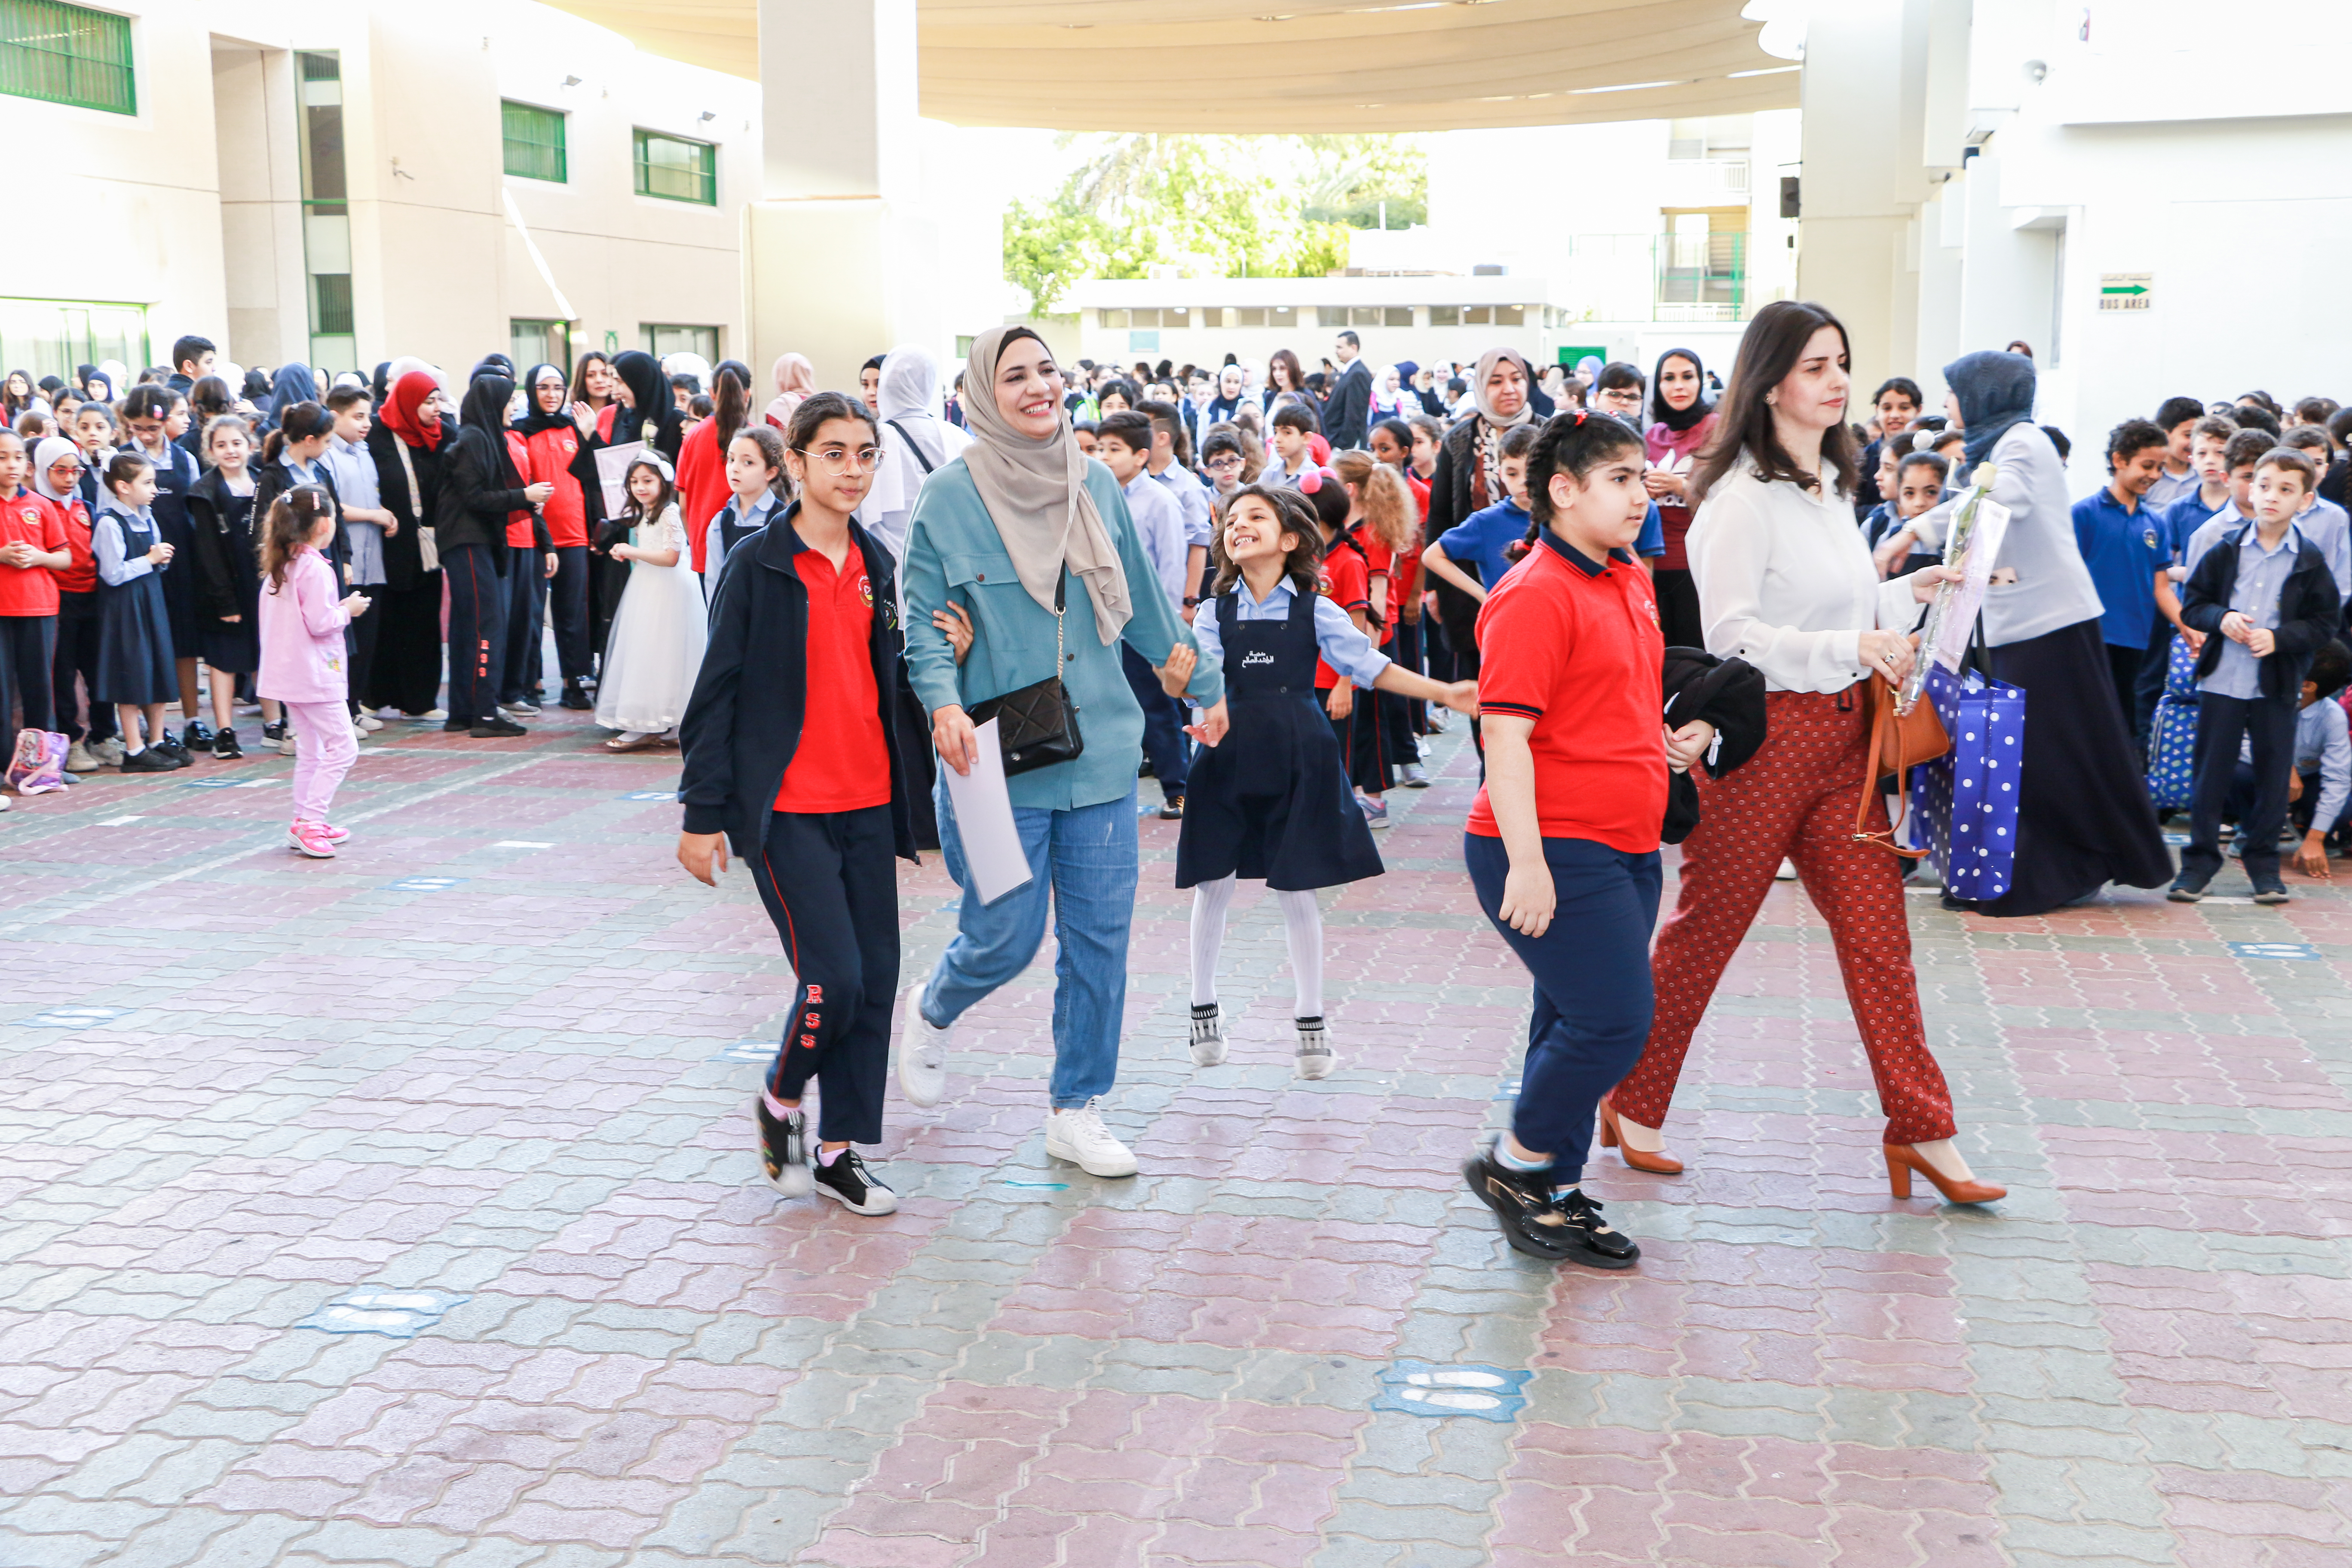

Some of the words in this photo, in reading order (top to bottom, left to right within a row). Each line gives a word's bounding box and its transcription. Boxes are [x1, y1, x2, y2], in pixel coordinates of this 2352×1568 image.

[2099, 299, 2119, 309] BUS
[2124, 298, 2150, 308] AREA
[1242, 656, 1258, 668] الصالح
[800, 985, 824, 1049] RSS
